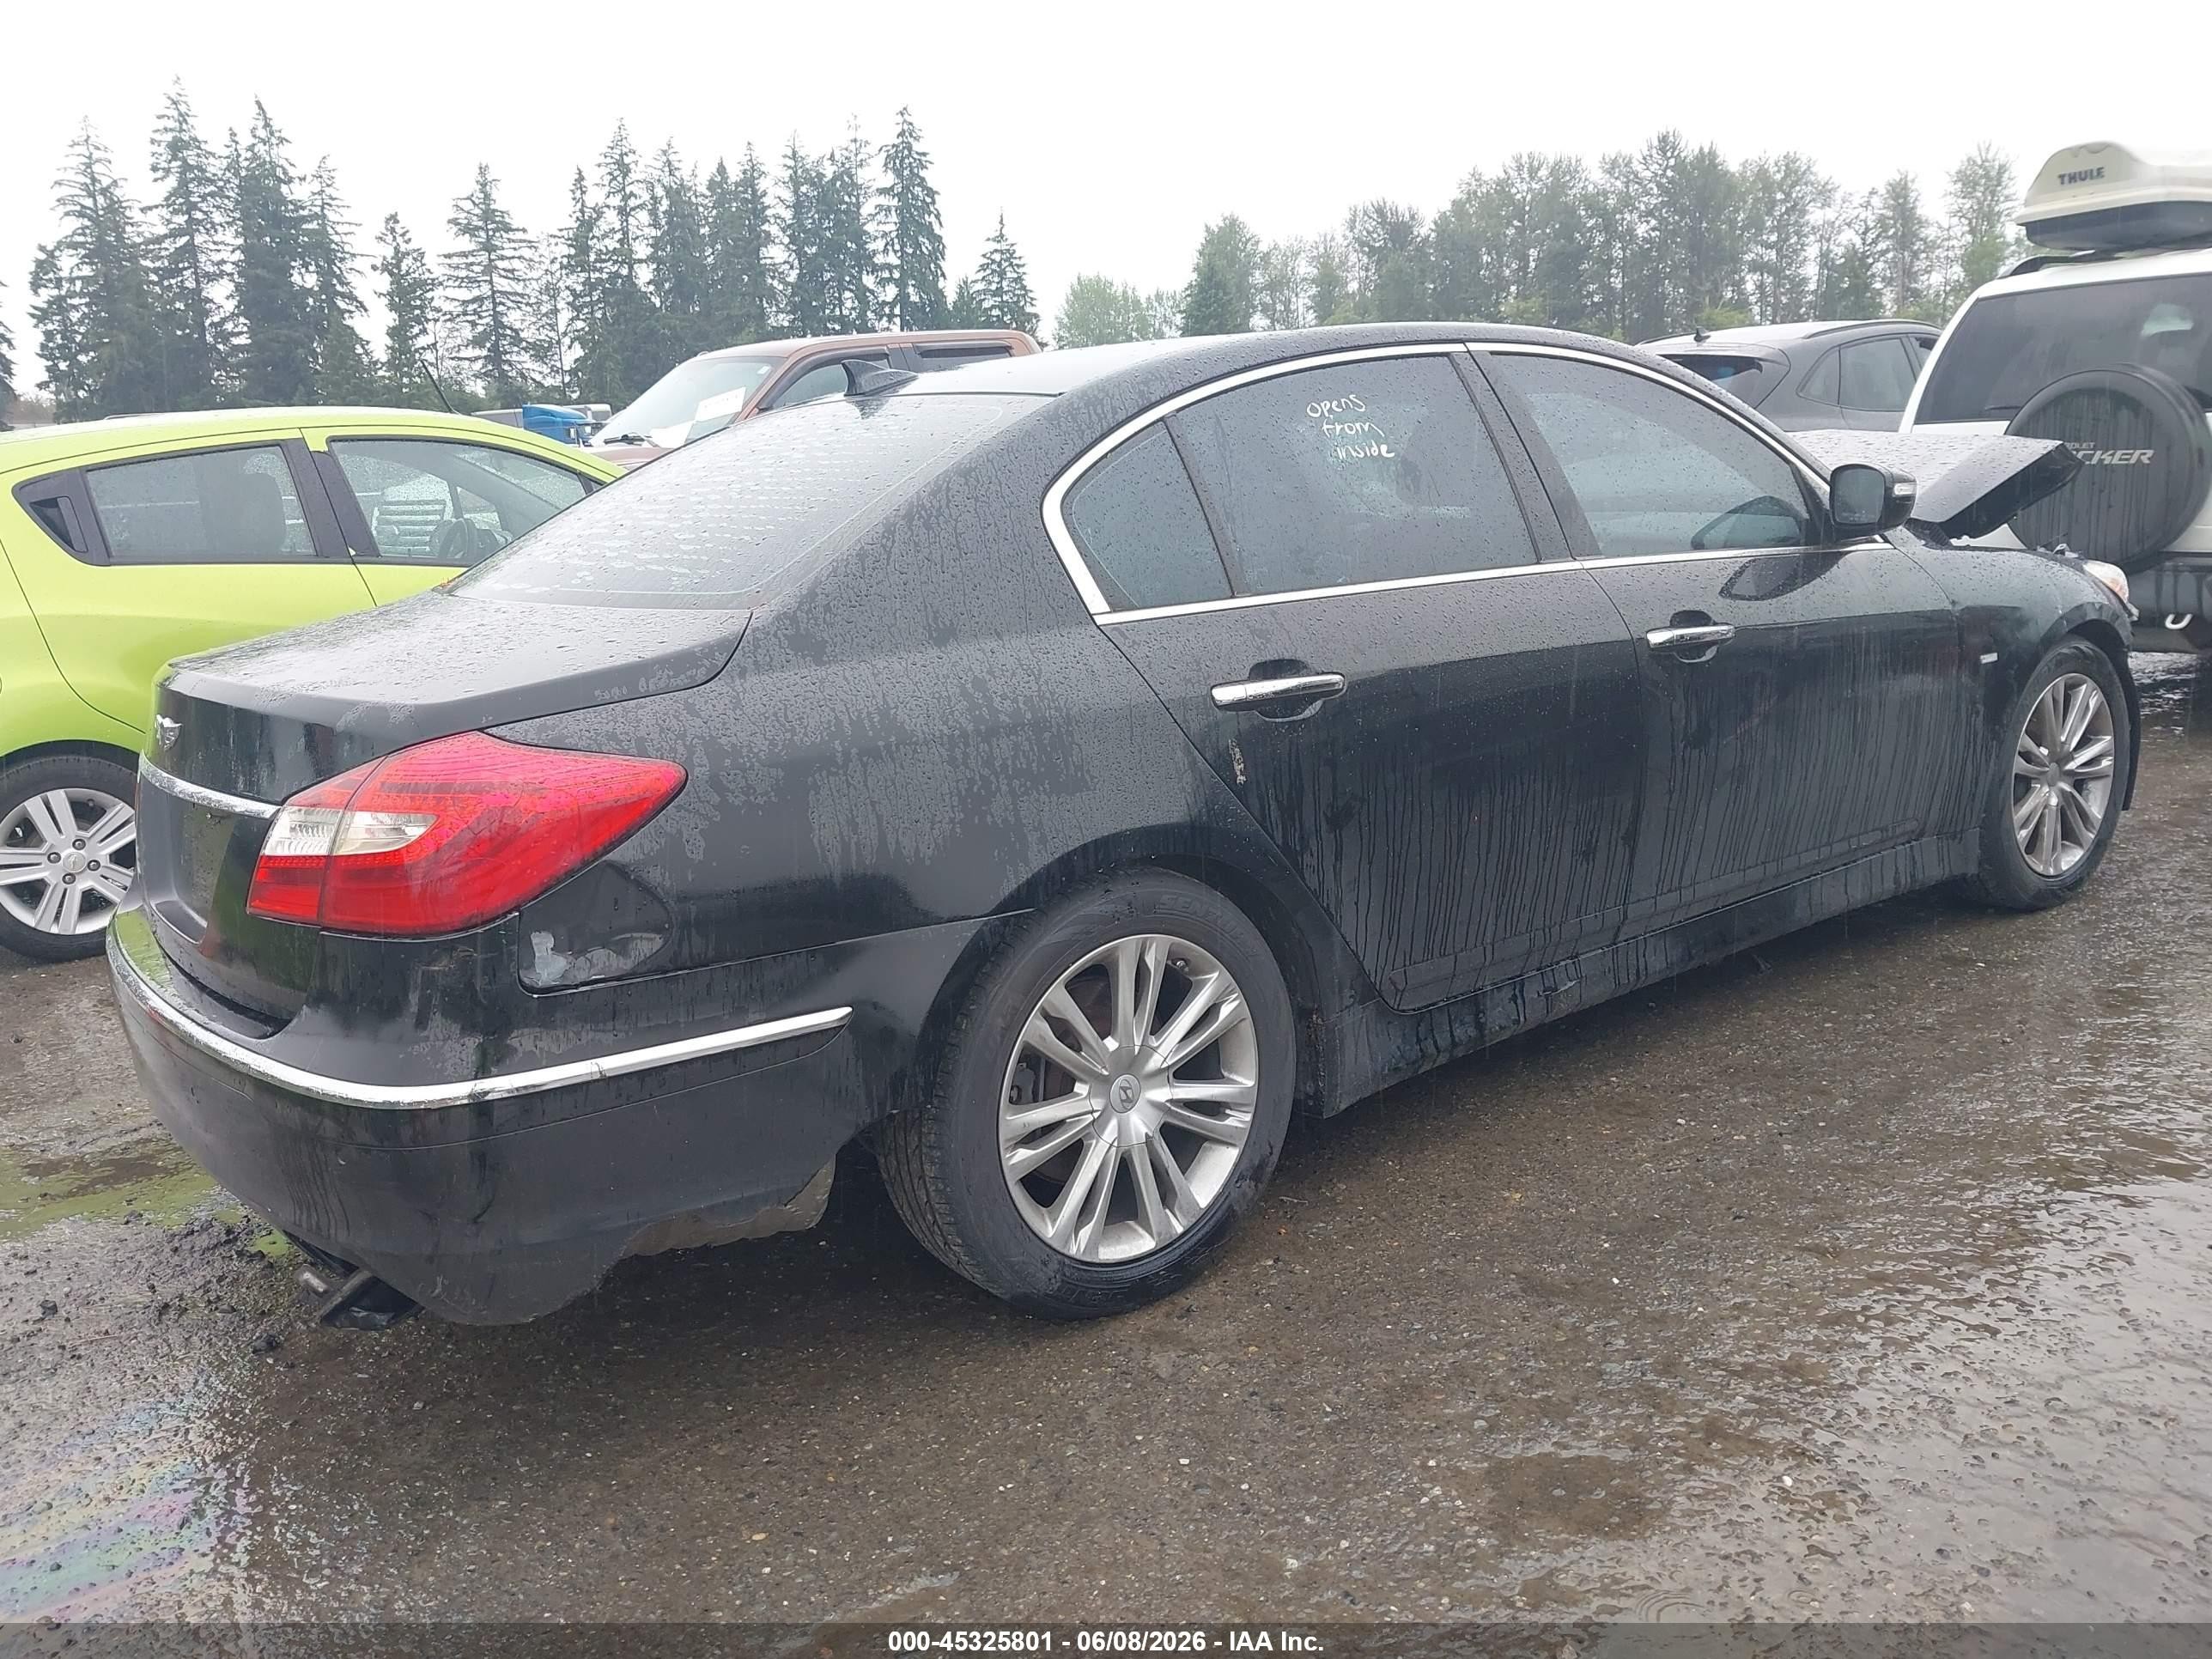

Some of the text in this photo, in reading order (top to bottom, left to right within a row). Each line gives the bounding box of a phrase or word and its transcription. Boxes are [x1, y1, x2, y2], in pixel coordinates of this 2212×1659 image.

[2057, 167, 2106, 185] THULE
[1322, 417, 1385, 438] from
[1334, 440, 1395, 460] inside
[2071, 449, 2154, 465] CKER
